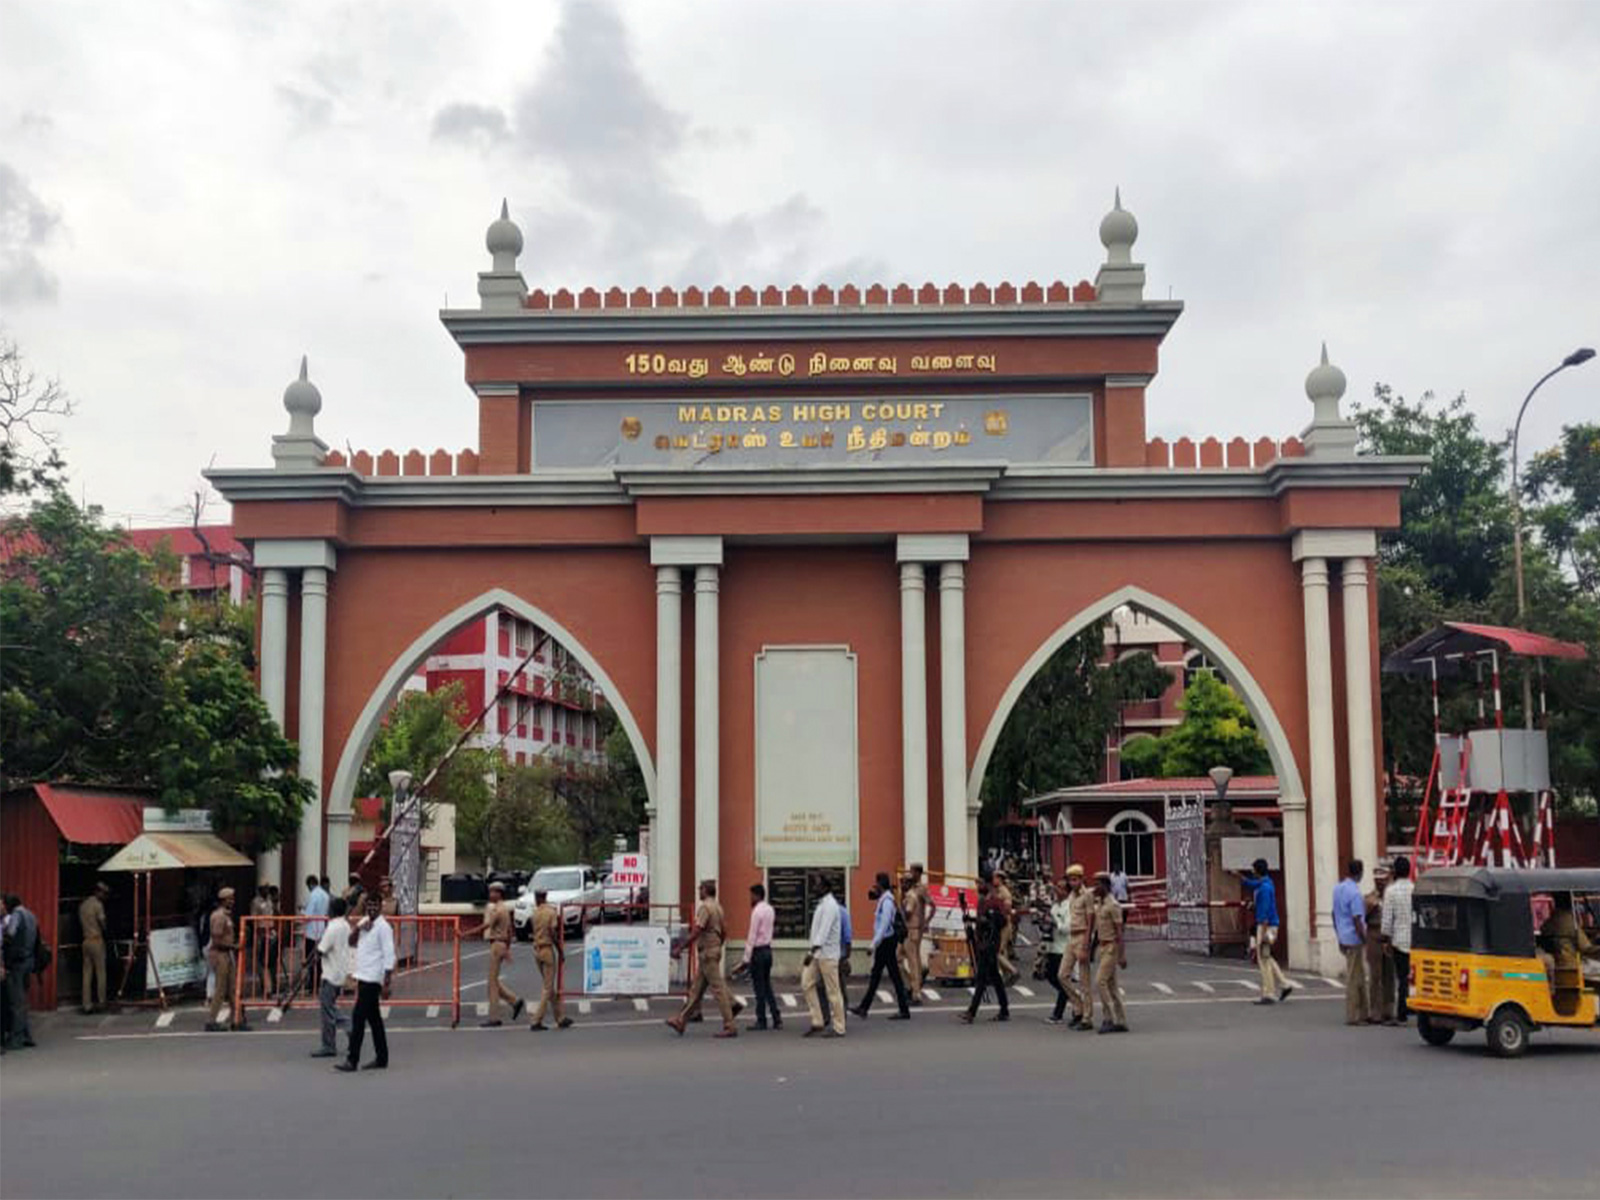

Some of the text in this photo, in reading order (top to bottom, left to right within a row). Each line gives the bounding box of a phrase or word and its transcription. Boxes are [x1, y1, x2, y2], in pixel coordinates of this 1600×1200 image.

[625, 353, 709, 378] 150வது
[722, 352, 796, 376] ஆண்டு
[808, 352, 897, 376] நினைவு
[678, 403, 944, 422] MADRAS HIGH COURT
[623, 856, 637, 868] NO
[613, 872, 645, 883] ENTRY
